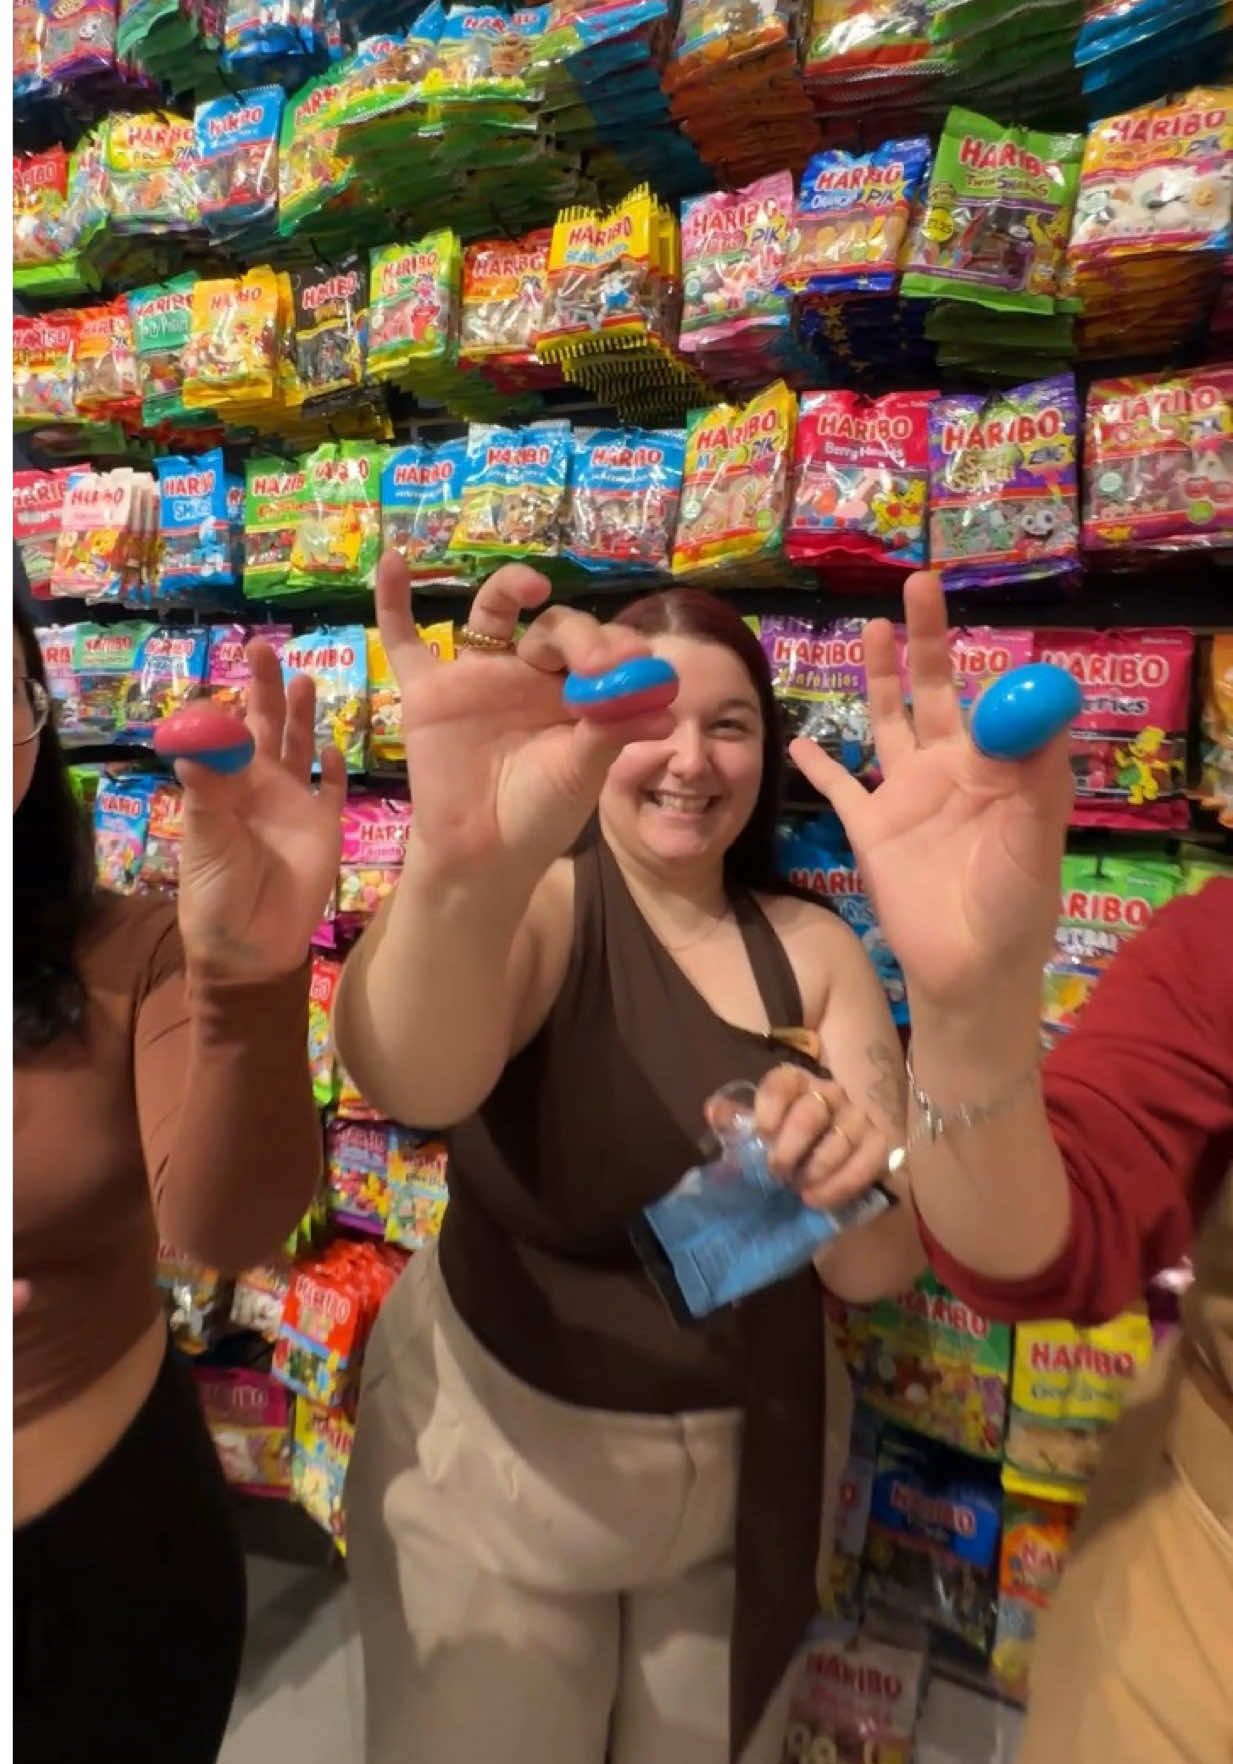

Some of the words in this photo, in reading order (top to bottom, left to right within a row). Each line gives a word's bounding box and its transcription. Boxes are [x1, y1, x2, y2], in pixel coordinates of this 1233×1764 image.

[959, 136, 1061, 181] HARIB
[696, 409, 777, 451] HARIBO
[818, 413, 912, 441] HARIBO
[943, 408, 1061, 454] HARIBO
[775, 638, 865, 667] HARIBO
[1042, 652, 1169, 688] ARIBO
